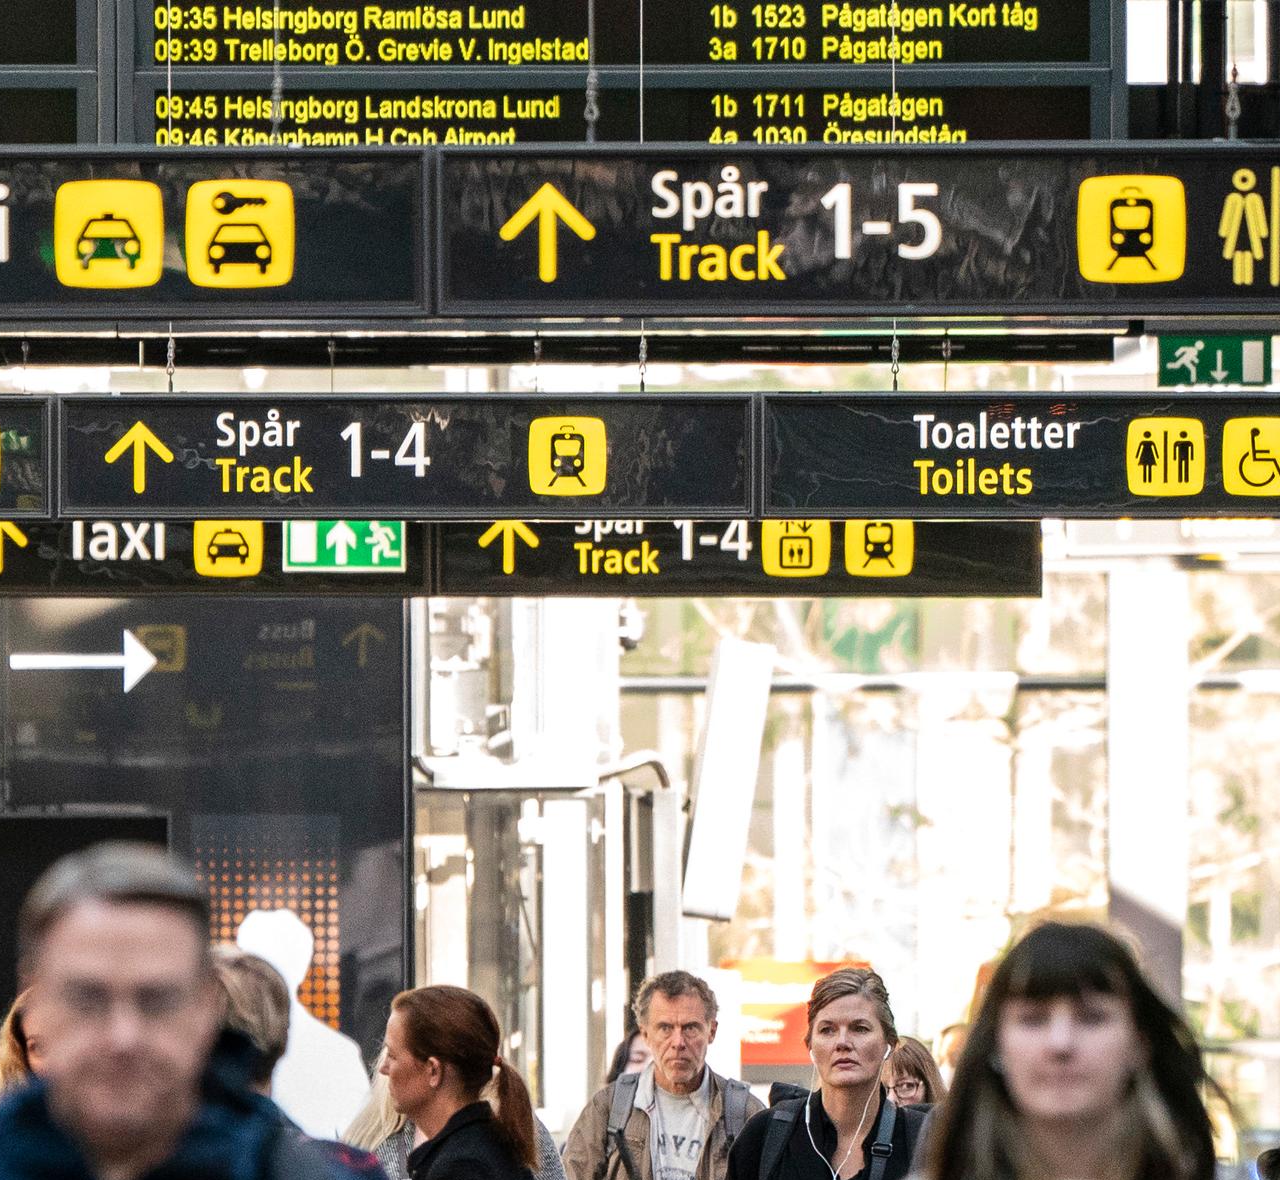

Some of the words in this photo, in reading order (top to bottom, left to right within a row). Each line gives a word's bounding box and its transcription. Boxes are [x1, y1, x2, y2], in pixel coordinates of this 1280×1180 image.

[155, 6, 217, 29] 09:35
[224, 6, 358, 33] Helsingborg
[364, 6, 462, 29] Ramlösa
[469, 6, 524, 29] Lund
[711, 5, 737, 28] 1b
[752, 4, 806, 28] 1523
[822, 2, 942, 32] Pågatågen
[949, 3, 996, 26] Kort
[1002, 2, 1038, 30] tåg
[155, 39, 217, 61] 09:39
[224, 39, 338, 66] Trelleborg
[346, 35, 370, 61] Ö.
[378, 38, 452, 61] Grevie
[459, 38, 480, 60] V.
[489, 38, 589, 65] Ingelstad
[710, 37, 736, 60] 3a
[752, 37, 806, 59] 1710
[823, 35, 942, 64] Pågatågen
[156, 96, 217, 119] 09:45
[225, 96, 358, 123] Helsingborg
[366, 96, 496, 118] Landskrona
[504, 96, 559, 118] Lund
[712, 95, 737, 117] 1b
[753, 94, 803, 117] 1711
[824, 93, 943, 119] Pågatågen
[156, 128, 217, 145] 09:46
[366, 128, 383, 144] H
[709, 127, 738, 144] 4a
[753, 126, 807, 144] 1030
[652, 166, 767, 230] Spår
[821, 183, 941, 259] 1-5
[651, 231, 785, 280] Track
[217, 409, 300, 456] Spår
[340, 421, 430, 477] 1-4
[913, 412, 1080, 449] Toaletter
[216, 458, 313, 492] Track
[915, 458, 1032, 494] Toilets
[574, 541, 658, 574] Track
[674, 520, 751, 560] 1-4
